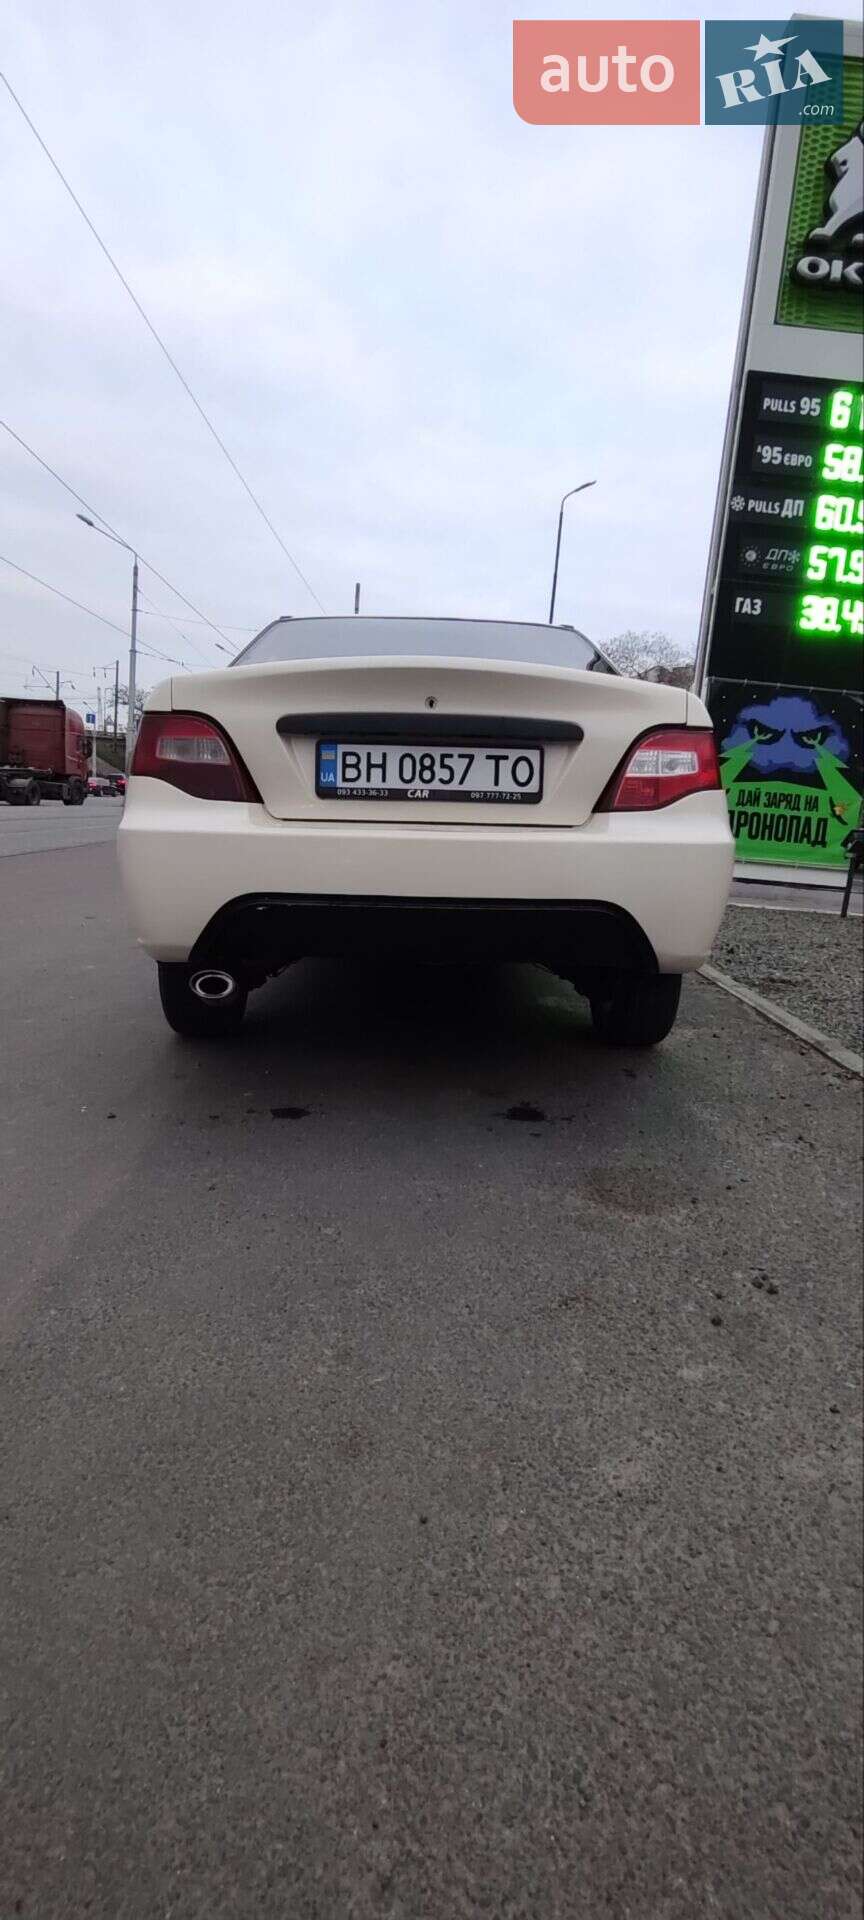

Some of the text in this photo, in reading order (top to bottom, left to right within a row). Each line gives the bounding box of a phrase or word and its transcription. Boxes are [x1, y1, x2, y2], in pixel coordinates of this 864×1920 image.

[763, 398, 796, 413] PULLS
[800, 397, 821, 416] 95
[783, 453, 812, 468] ЄВРО
[747, 499, 780, 514] PULLS
[780, 499, 805, 518] ДП
[765, 548, 789, 561] ДП
[734, 596, 762, 615] ГАЗ
[320, 771, 335, 783] UA
[341, 751, 534, 788] BH 0857 TO
[407, 789, 430, 799] CAR
[736, 788, 819, 812] ДАЙ ЗАРЯД НА
